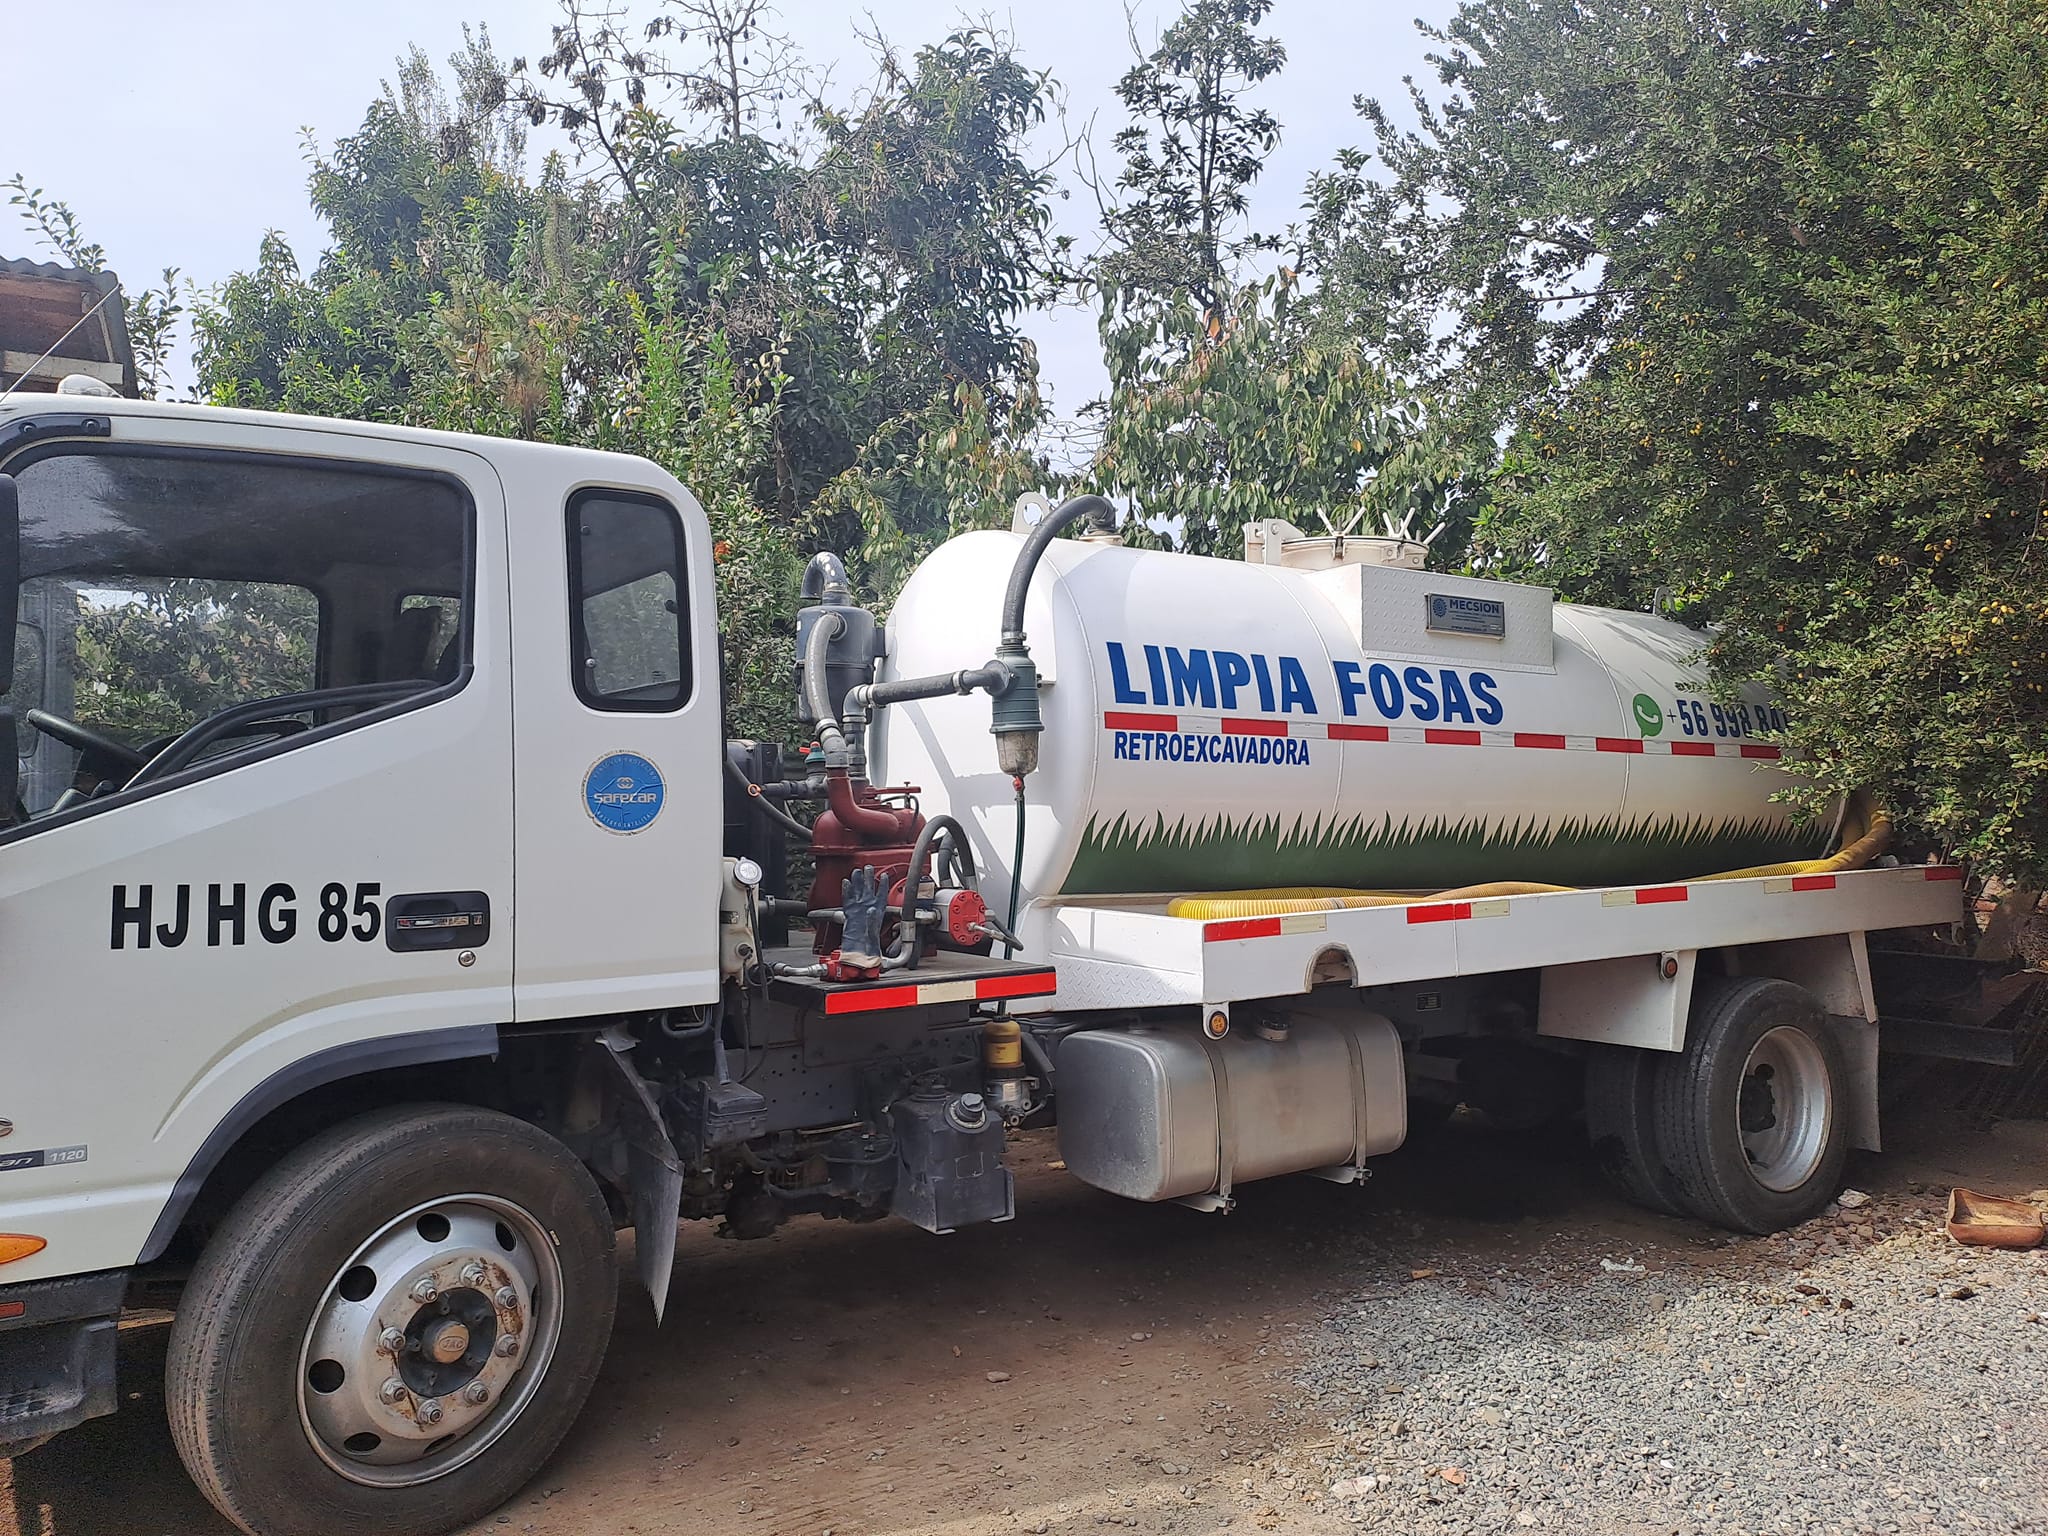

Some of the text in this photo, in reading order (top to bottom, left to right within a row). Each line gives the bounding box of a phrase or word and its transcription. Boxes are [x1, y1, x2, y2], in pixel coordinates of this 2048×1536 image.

[1449, 599, 1500, 614] MECSION
[1106, 642, 1503, 725] LIMPIA FOSAS
[1667, 700, 1709, 736] +56
[1114, 731, 1310, 766] RETROEXCAVADORA
[318, 883, 381, 943] 85
[50, 1149, 85, 1162] 1120
